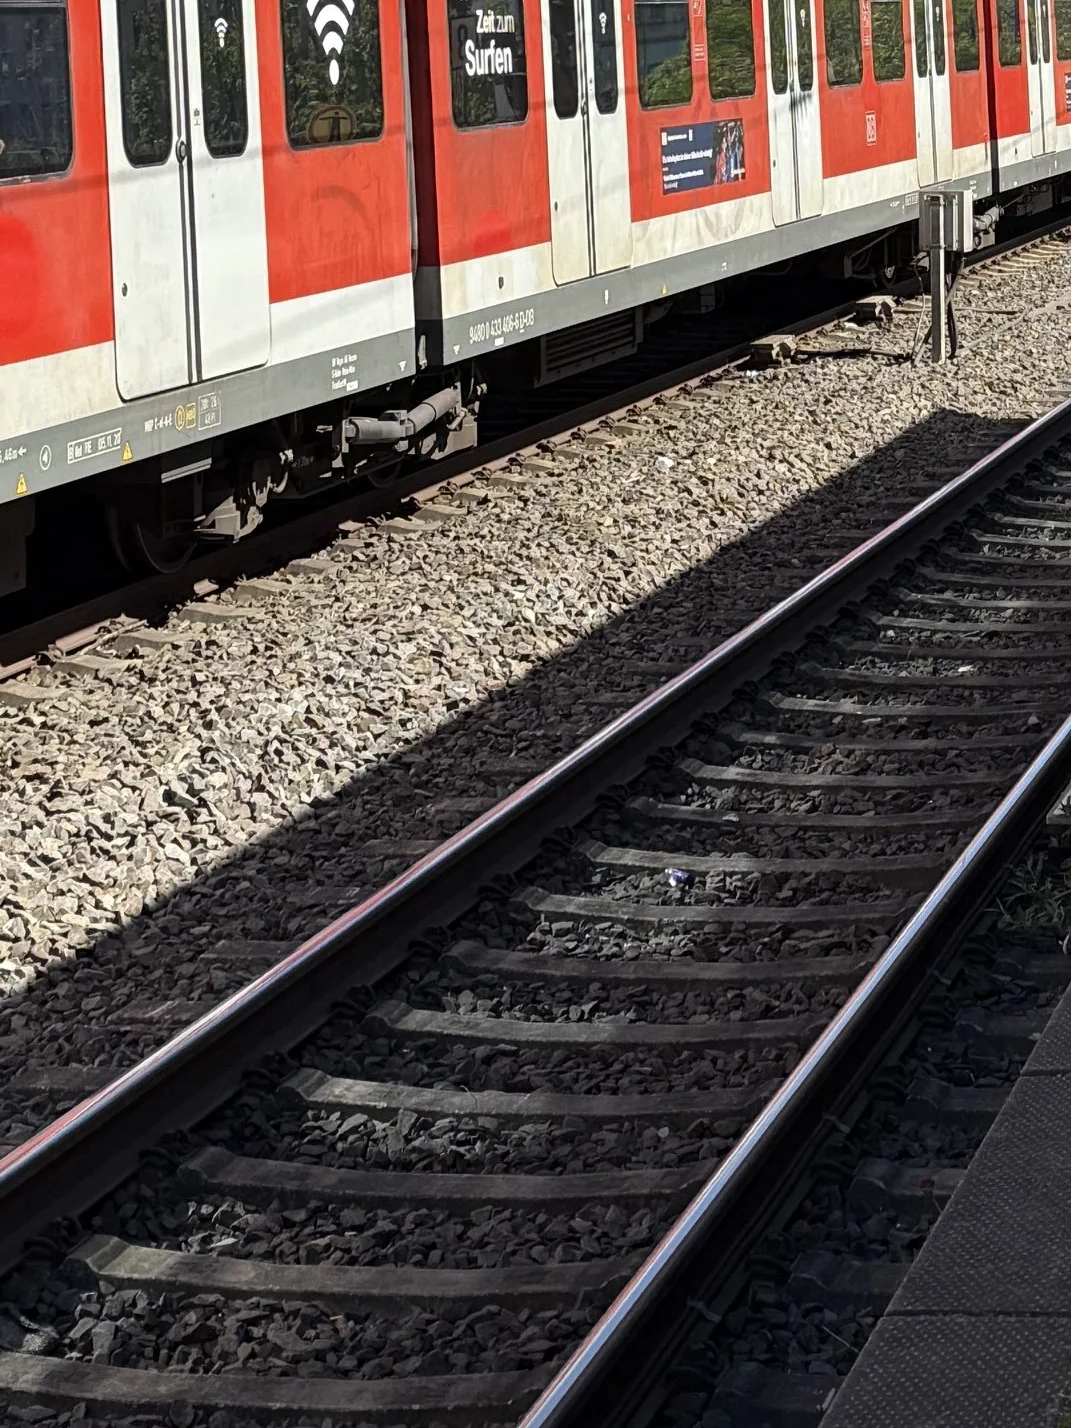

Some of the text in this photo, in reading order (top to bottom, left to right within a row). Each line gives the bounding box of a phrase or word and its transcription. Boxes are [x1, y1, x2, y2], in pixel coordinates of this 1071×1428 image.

[476, 9, 515, 34] Zeit zum
[465, 39, 513, 76] Surfen
